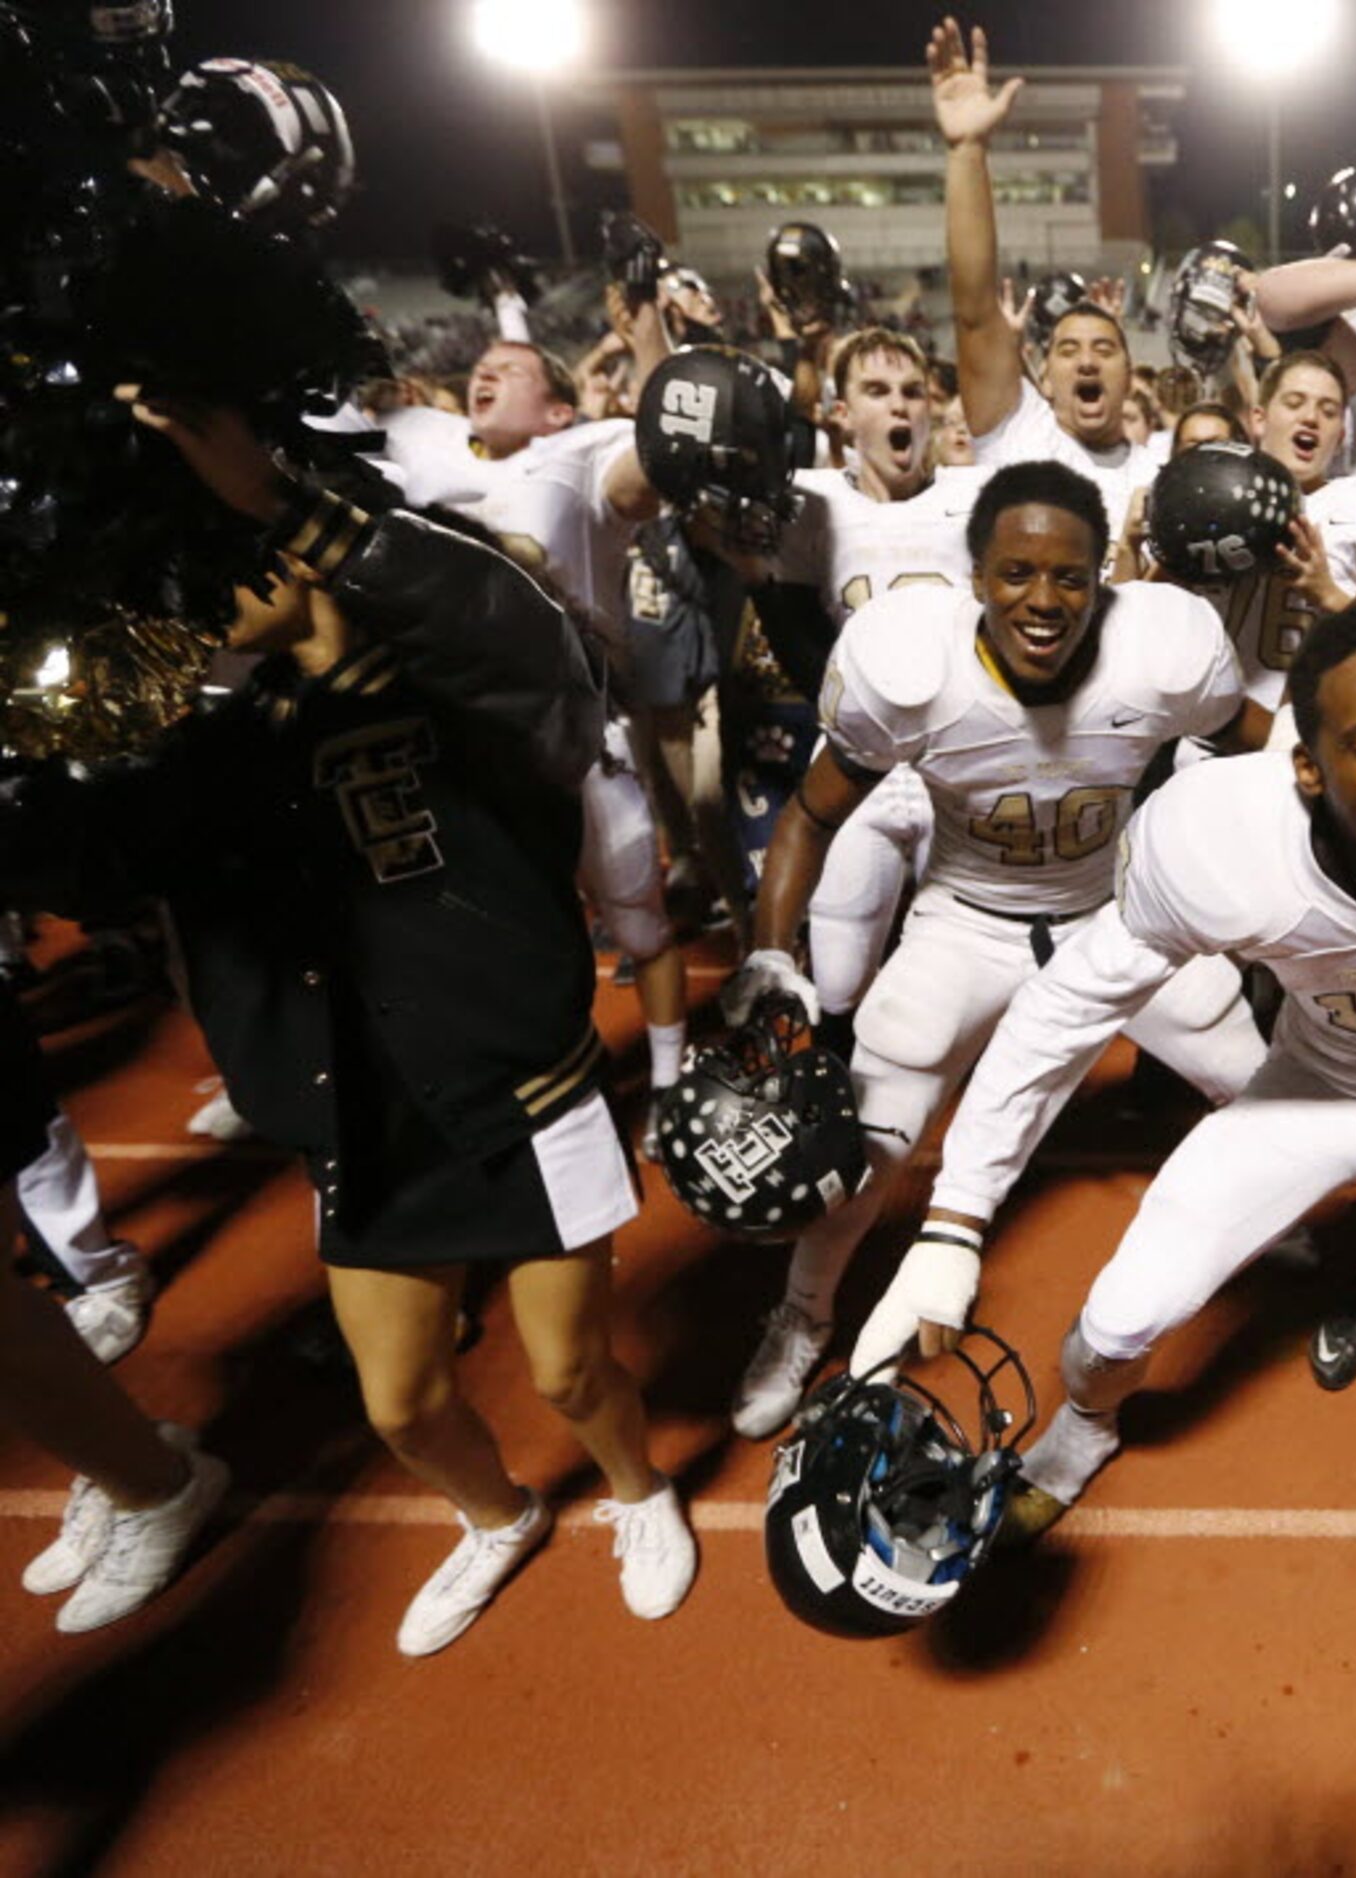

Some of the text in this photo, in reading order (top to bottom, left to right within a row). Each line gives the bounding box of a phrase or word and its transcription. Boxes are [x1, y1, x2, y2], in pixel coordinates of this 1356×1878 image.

[660, 379, 718, 443] 12
[1187, 534, 1254, 574] 76
[969, 784, 1128, 867] 40
